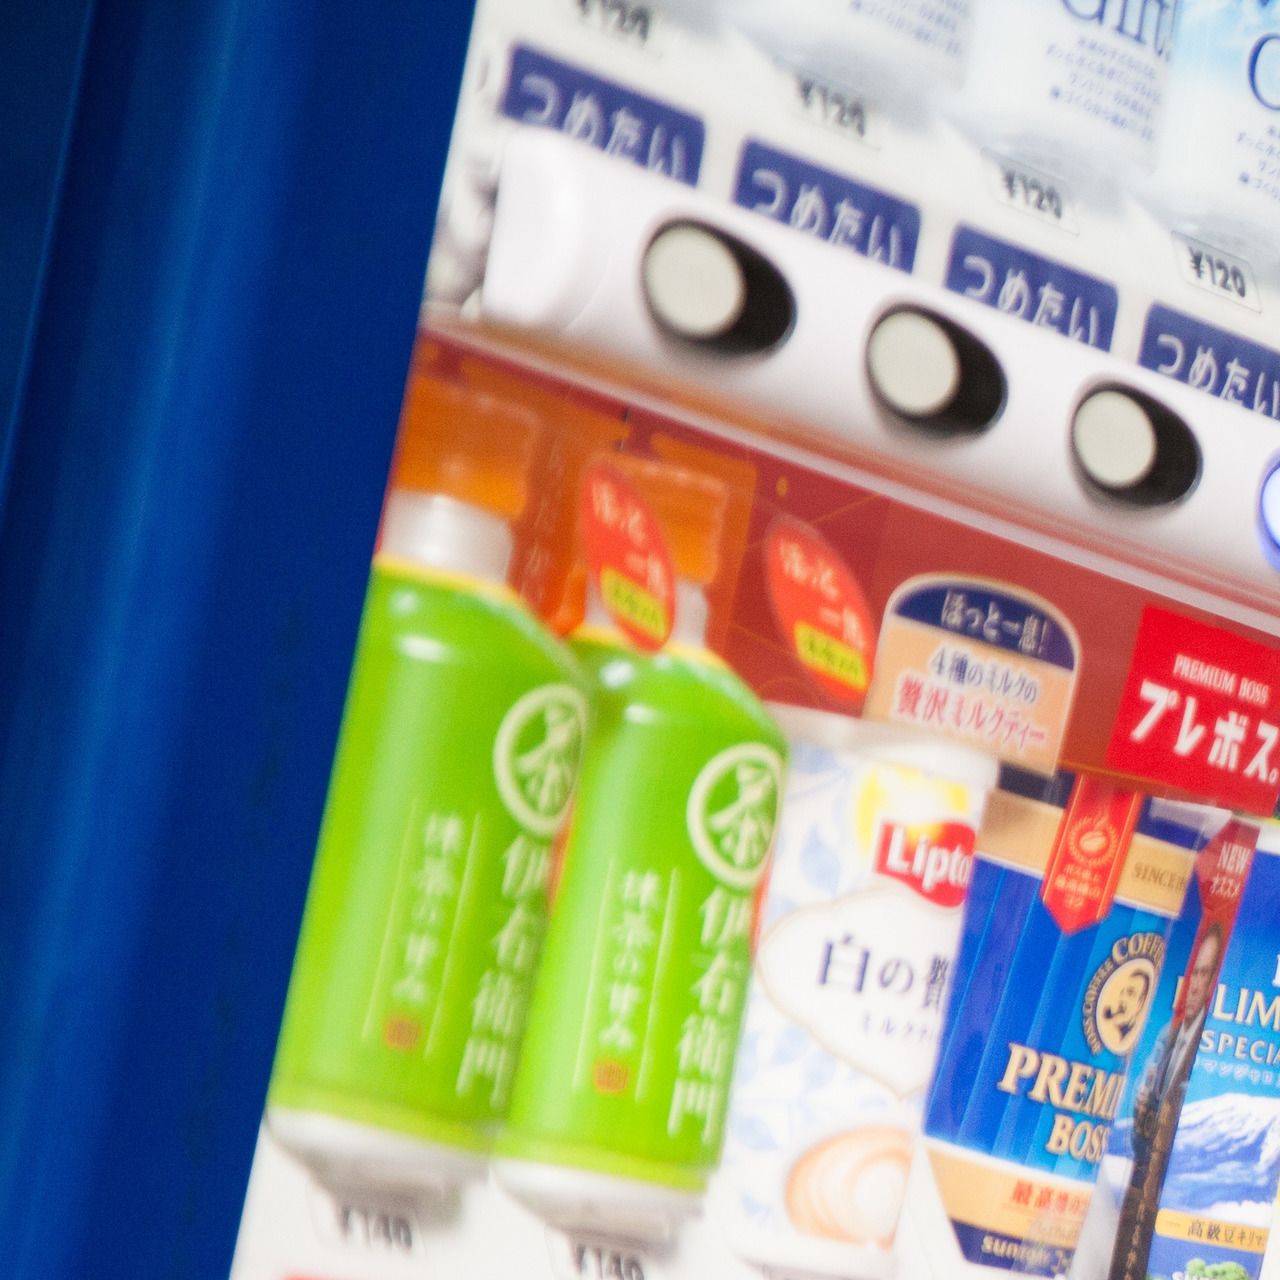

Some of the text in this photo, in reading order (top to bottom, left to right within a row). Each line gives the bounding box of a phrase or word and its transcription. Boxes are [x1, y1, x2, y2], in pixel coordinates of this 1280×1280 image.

[961, 254, 1100, 347] つめたい
[1187, 249, 1247, 300] ¥120
[1156, 333, 1280, 420] つめたい
[941, 589, 1049, 658] ほっと一息!
[929, 646, 1039, 704] 4種のミルクの
[1172, 654, 1271, 705] PREMIUM BOSS
[895, 674, 1047, 754] 贅沢ミルクティー
[1130, 678, 1280, 788] プレボス。
[1216, 840, 1250, 876] NEW
